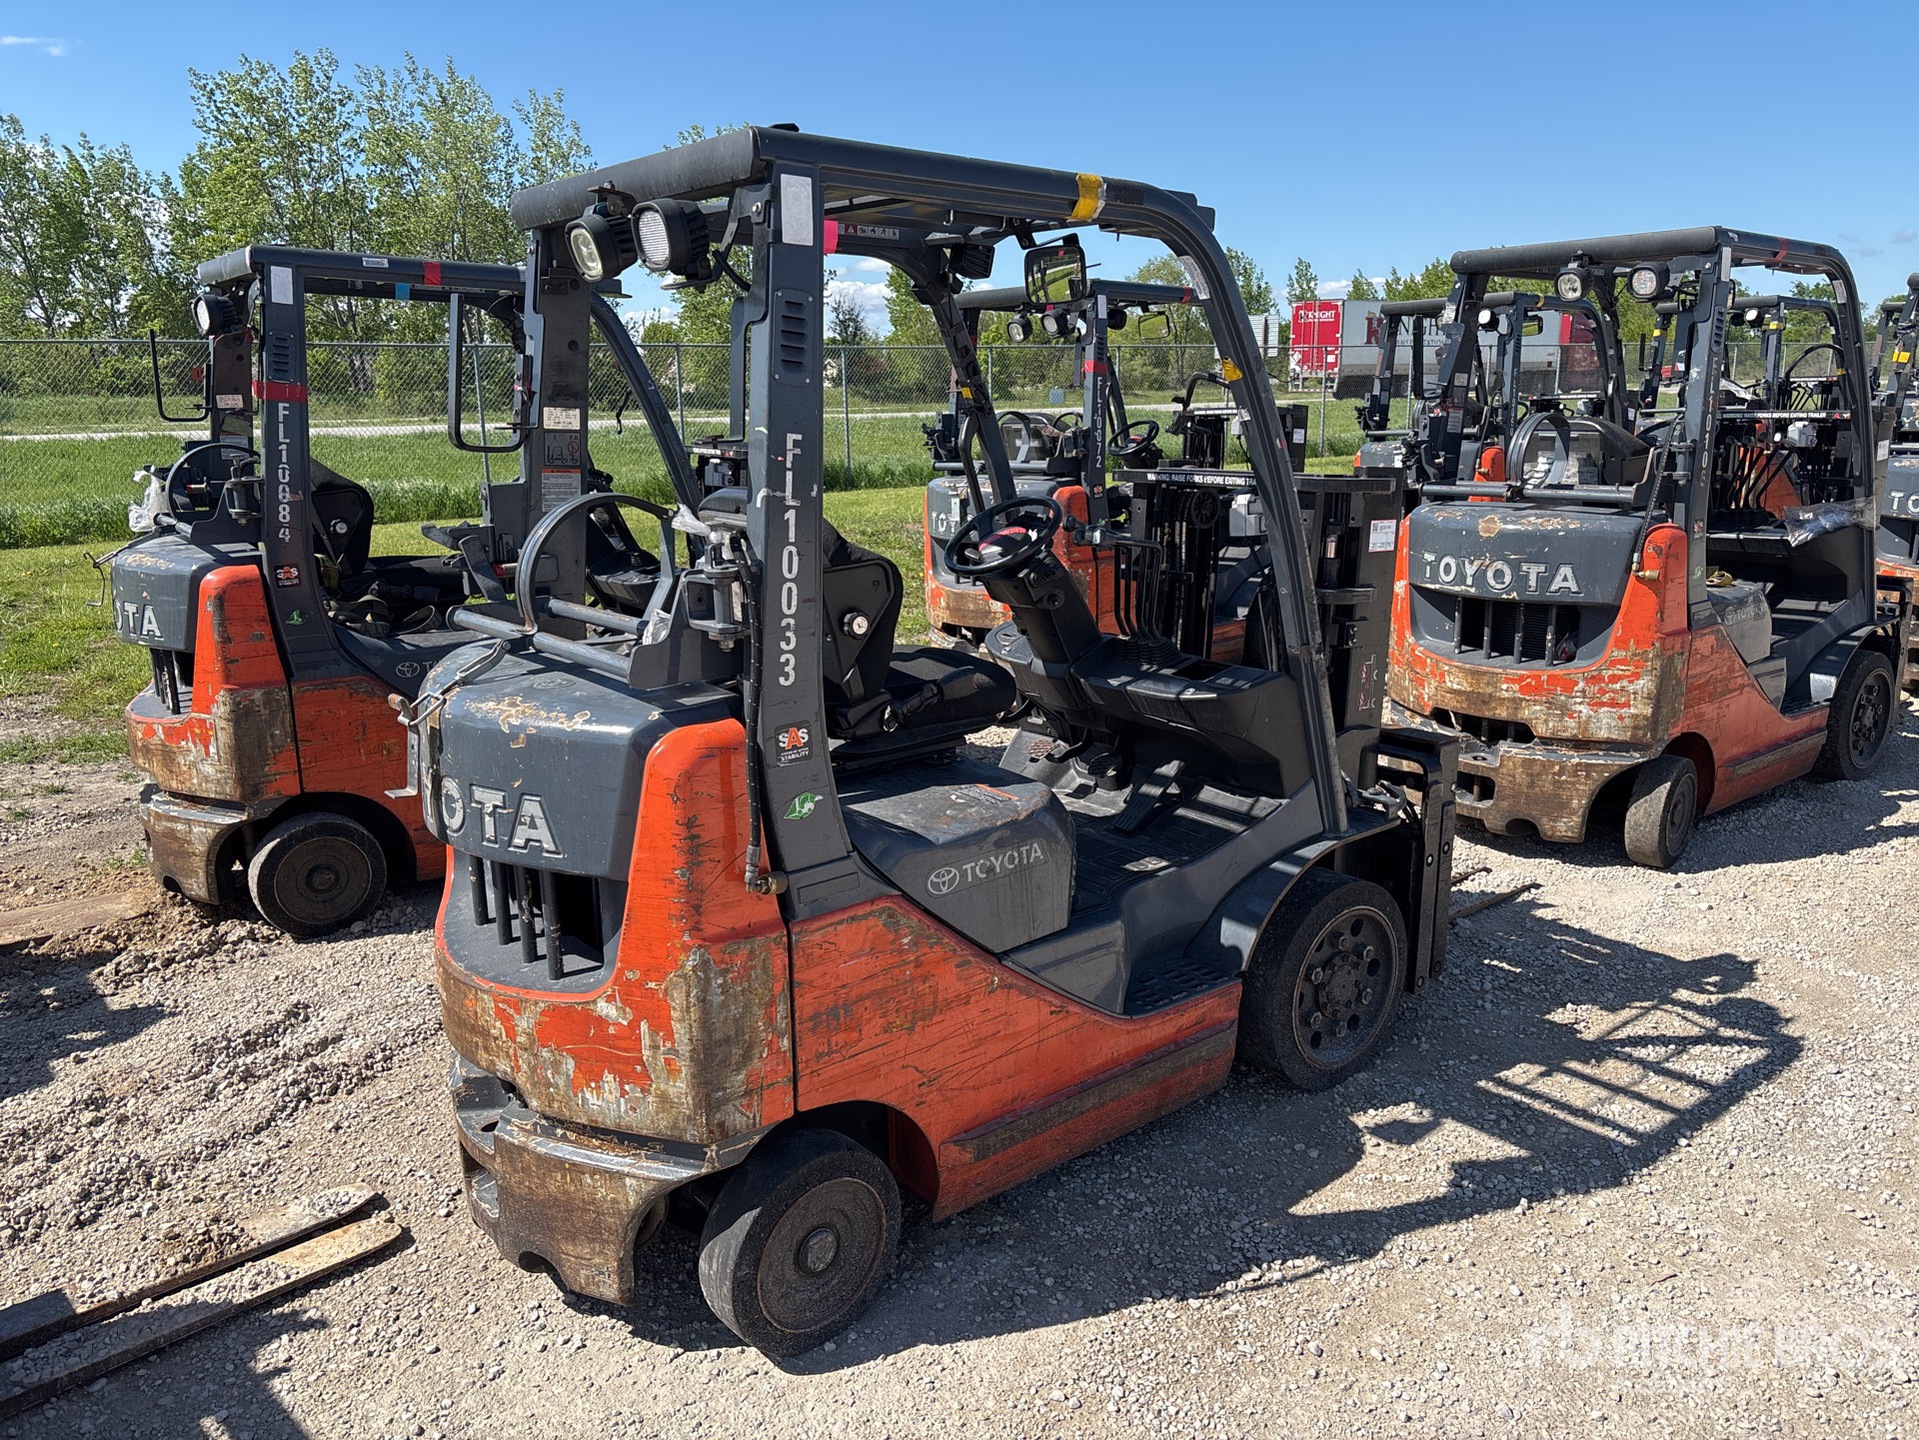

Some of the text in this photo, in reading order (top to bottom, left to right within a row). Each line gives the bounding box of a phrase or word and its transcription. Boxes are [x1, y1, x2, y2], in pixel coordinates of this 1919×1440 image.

[1172, 475, 1186, 483] RAISE
[1225, 478, 1245, 486] EXITING
[778, 433, 803, 688] FL10033
[1423, 551, 1584, 597] TOYOTA
[778, 727, 809, 750] SAS
[962, 842, 1044, 882] TOYOTA
